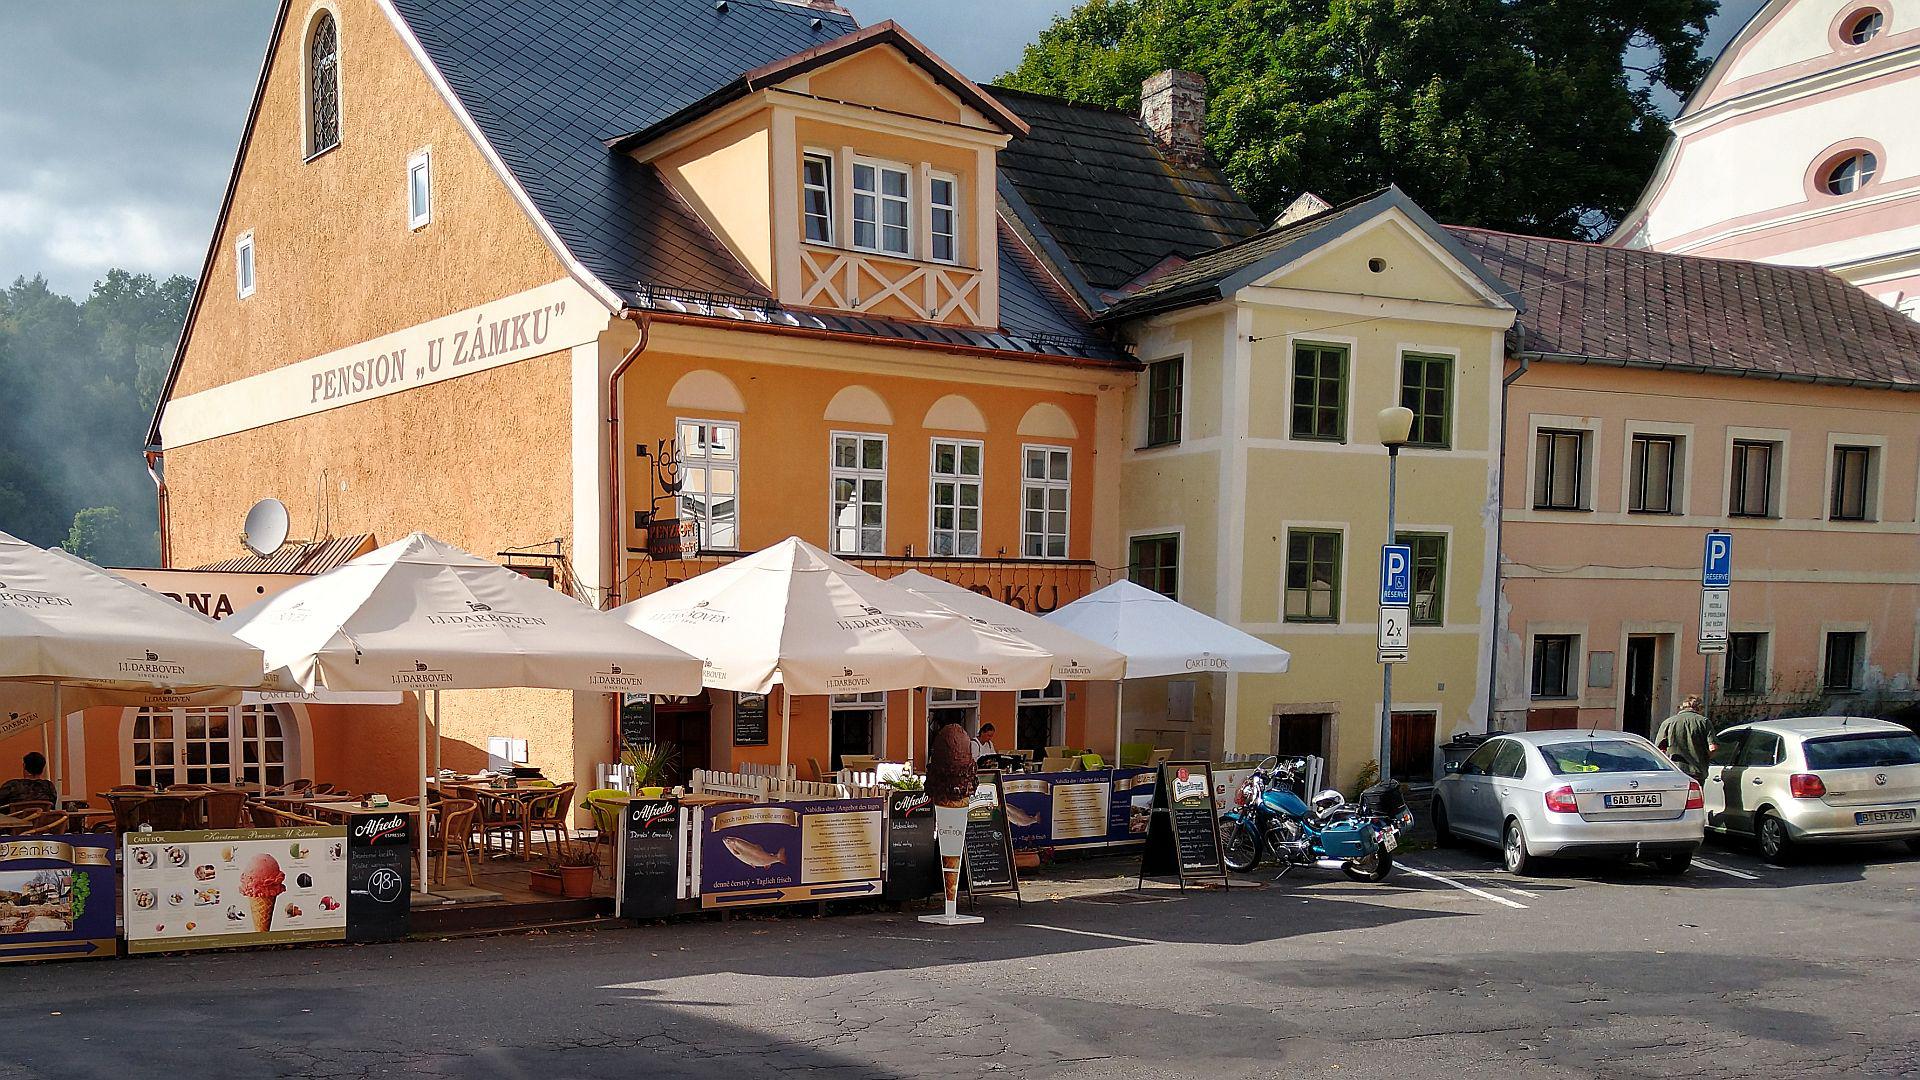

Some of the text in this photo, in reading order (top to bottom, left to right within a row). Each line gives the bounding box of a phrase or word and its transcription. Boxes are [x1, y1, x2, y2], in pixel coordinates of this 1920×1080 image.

[311, 348, 407, 404] PENSION
[1710, 540, 1726, 570] P
[1388, 553, 1405, 586] P
[895, 792, 929, 812] Alfredo
[1612, 794, 1657, 805] 6AB 8746
[632, 801, 673, 822] Alfredo
[1862, 813, 1869, 822] B
[354, 814, 402, 838] Alfredo
